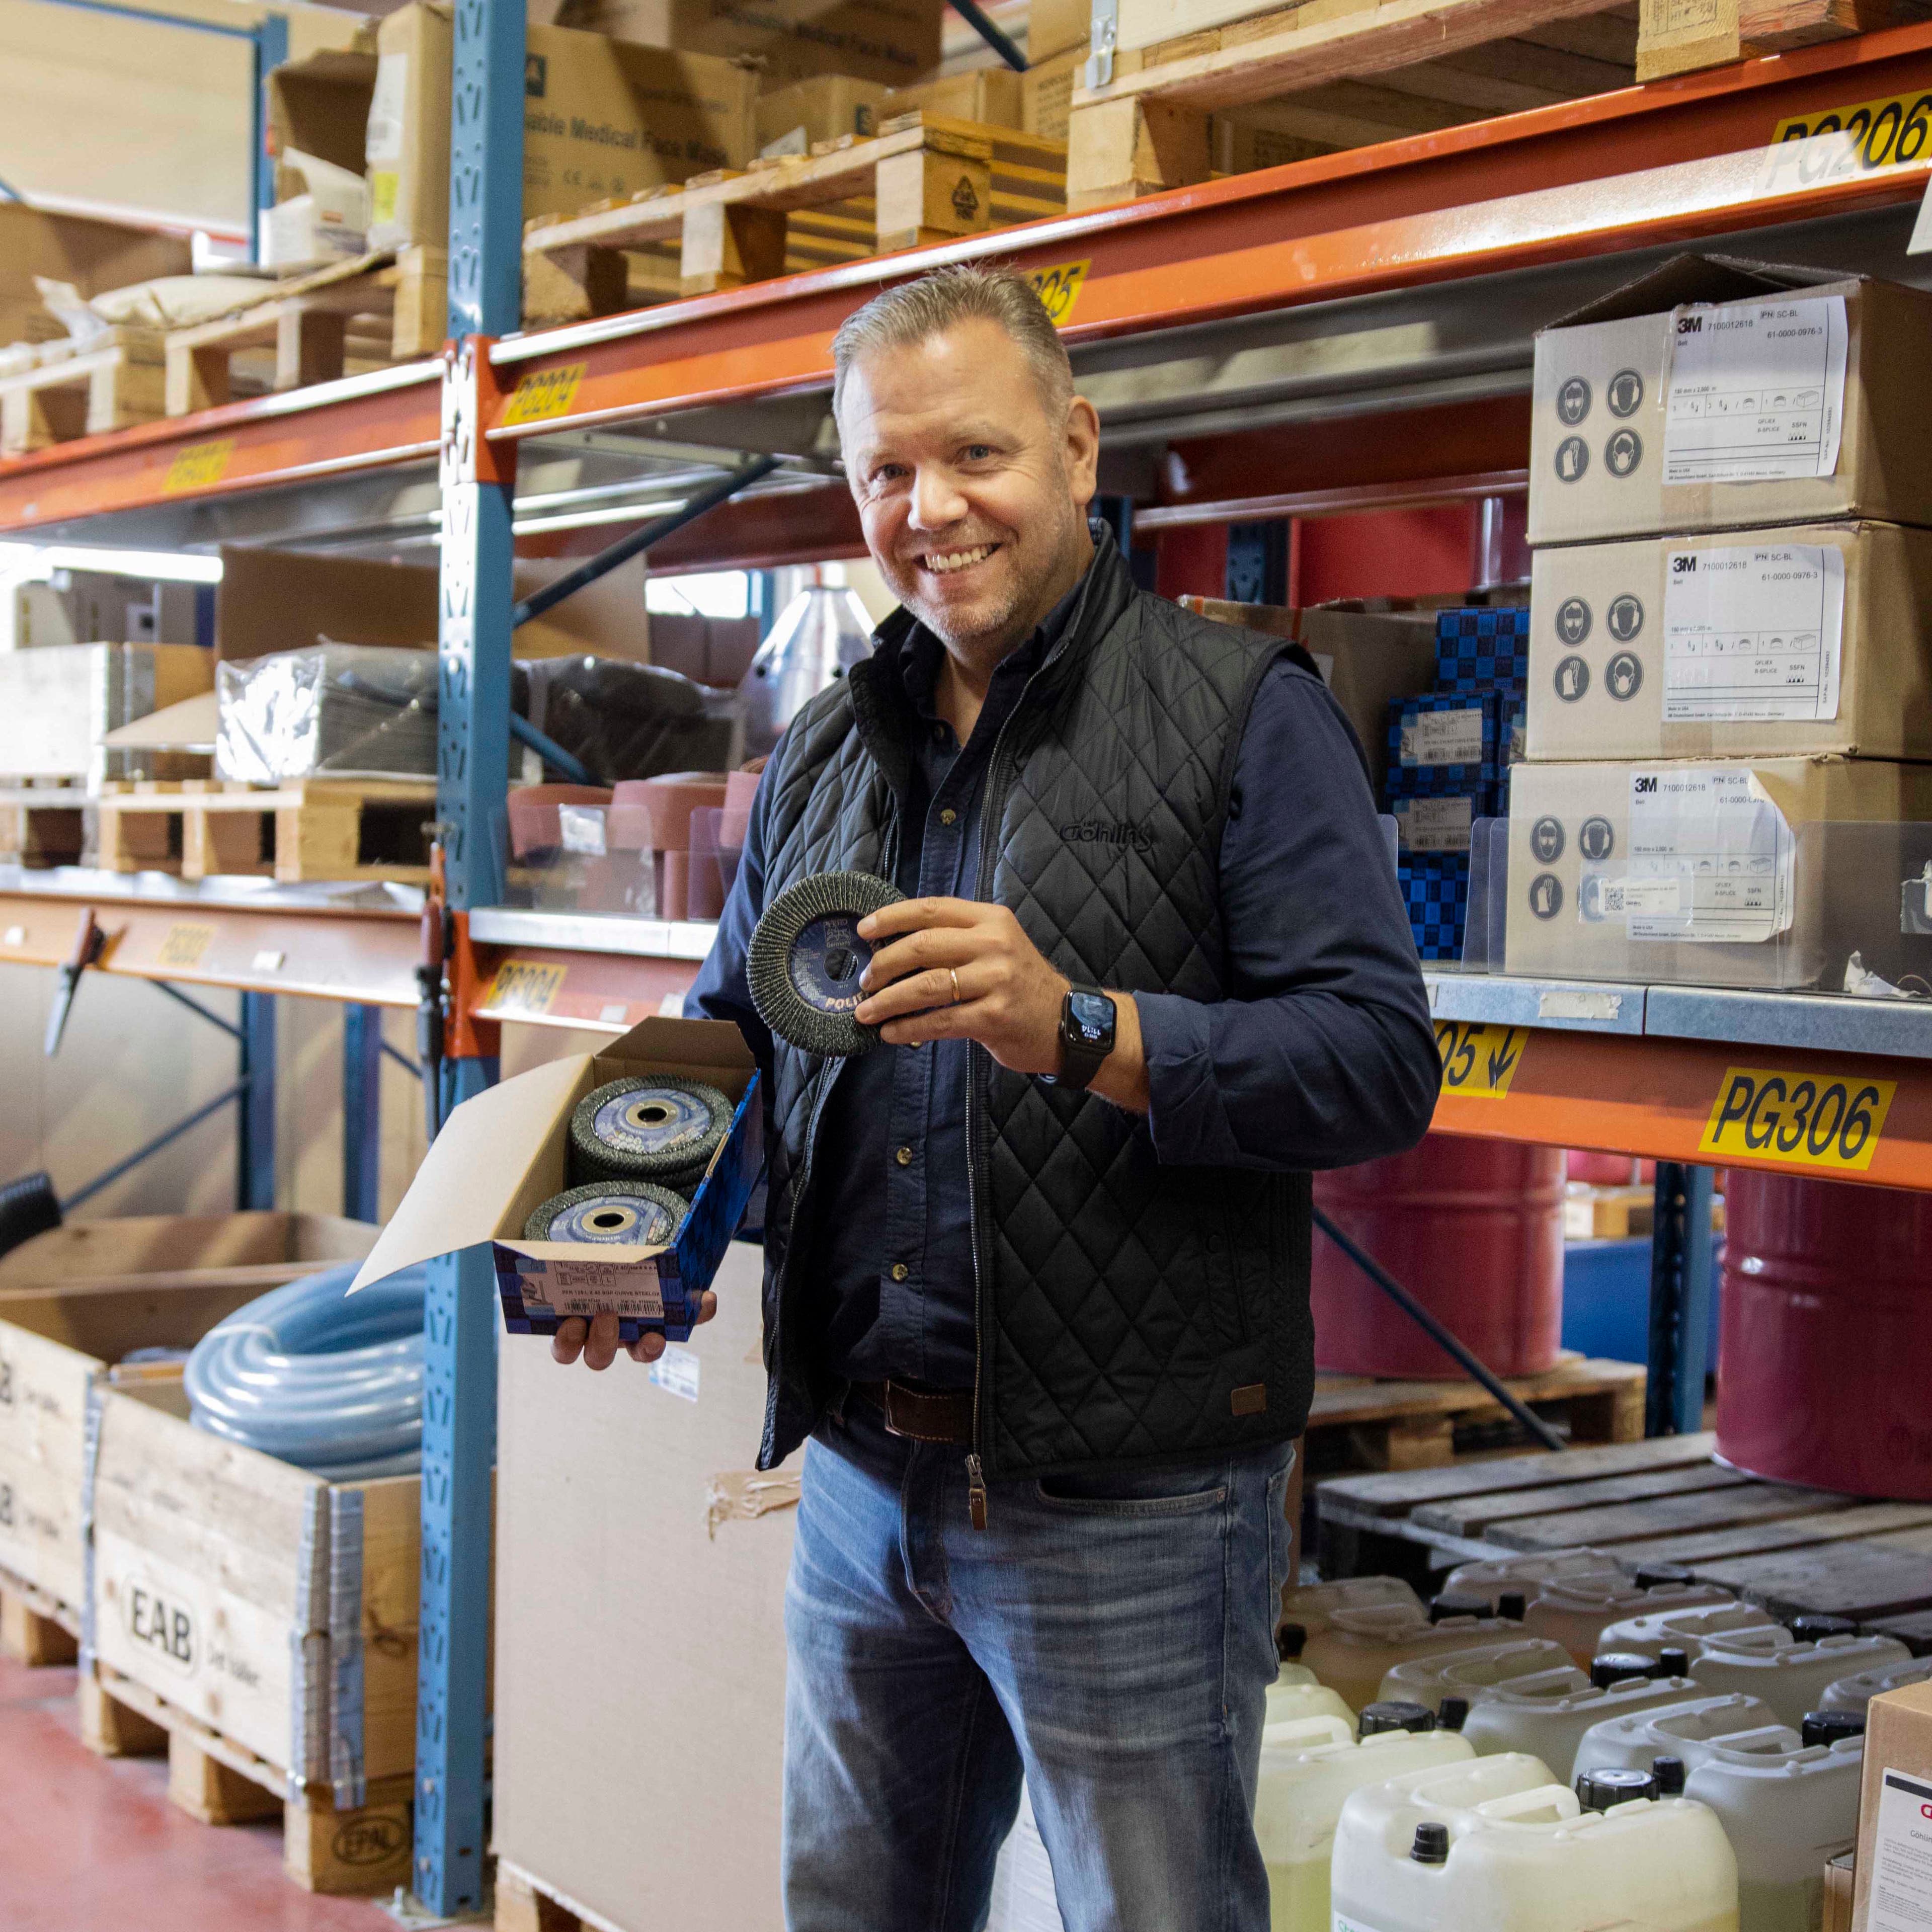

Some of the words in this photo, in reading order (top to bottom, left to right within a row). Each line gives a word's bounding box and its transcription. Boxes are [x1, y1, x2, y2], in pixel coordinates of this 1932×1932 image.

[1765, 94, 1932, 184] PG206
[1777, 309, 1798, 318] SC-BL
[1677, 316, 1703, 334] 3M
[1672, 556, 1697, 573] 3M
[1703, 562, 1747, 571] 7100012618
[1761, 572, 1818, 581] 61-0000-0976-3
[1635, 777, 1657, 793] 3M
[1663, 784, 1706, 792] 7100012618
[1081, 1024, 1101, 1035] 11:14
[1712, 1075, 1879, 1160] PG306
[131, 1586, 191, 1664] EAB
